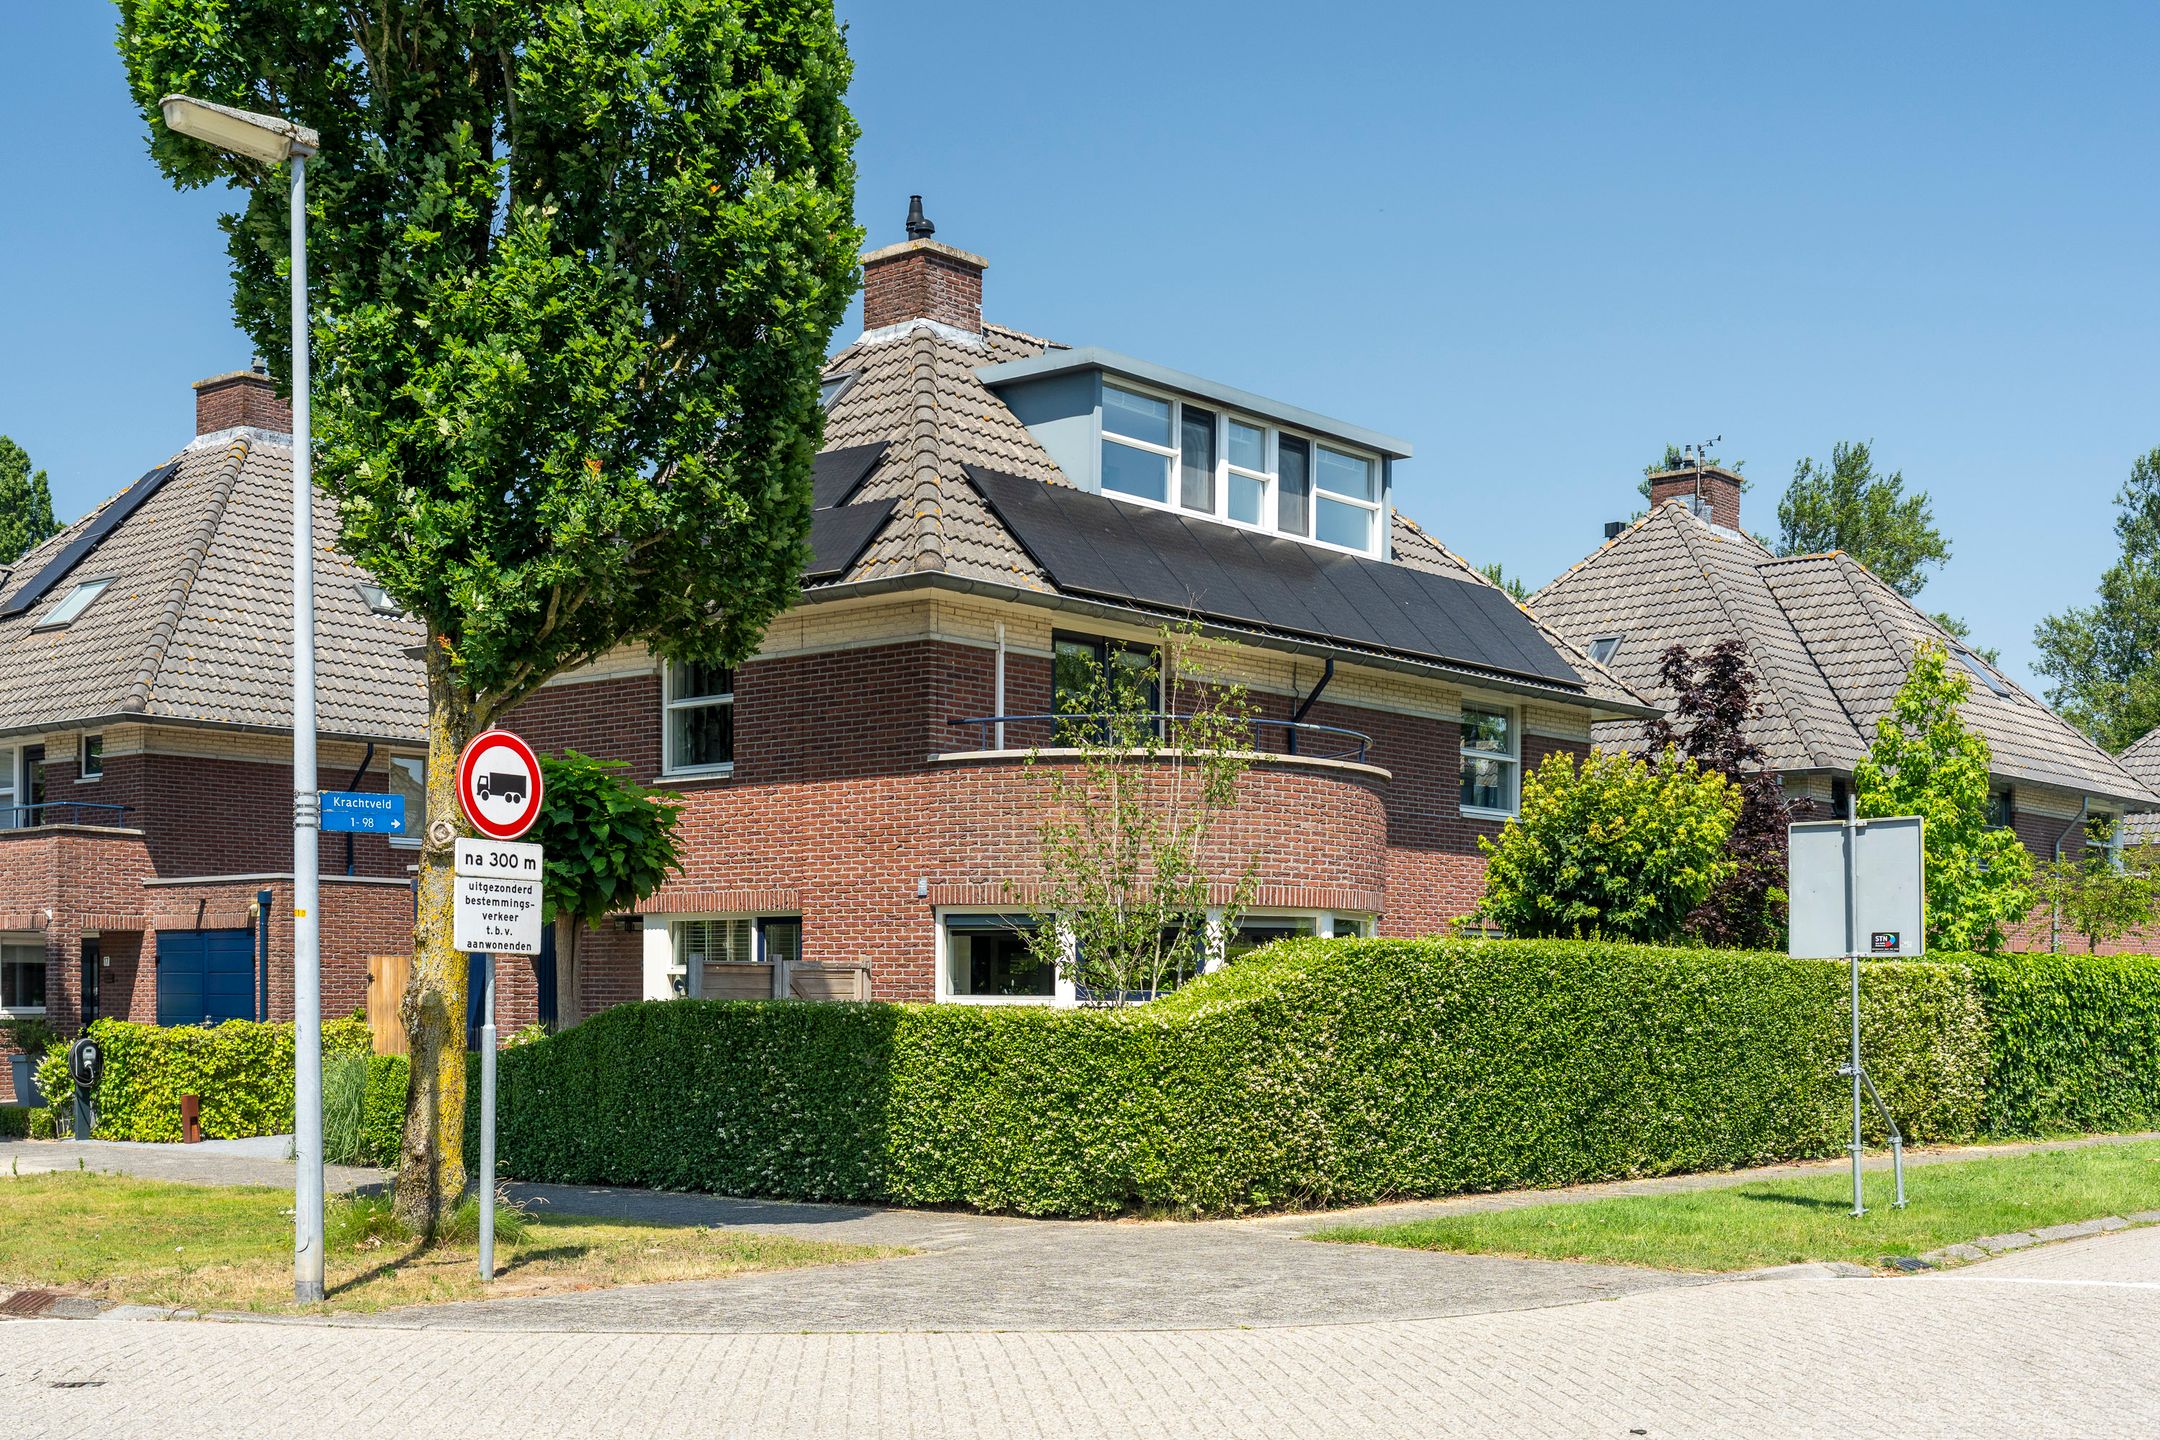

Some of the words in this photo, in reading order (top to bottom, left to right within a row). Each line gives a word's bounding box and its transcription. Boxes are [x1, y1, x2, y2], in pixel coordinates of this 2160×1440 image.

[333, 796, 392, 809] Krachtveld
[465, 853, 483, 866] na
[489, 852, 518, 868] 300
[524, 858, 536, 870] m
[468, 881, 533, 895] uitgezonderd
[465, 895, 535, 911] bestemmings-
[482, 912, 519, 922] verkeer
[466, 940, 532, 951] aanwonenden
